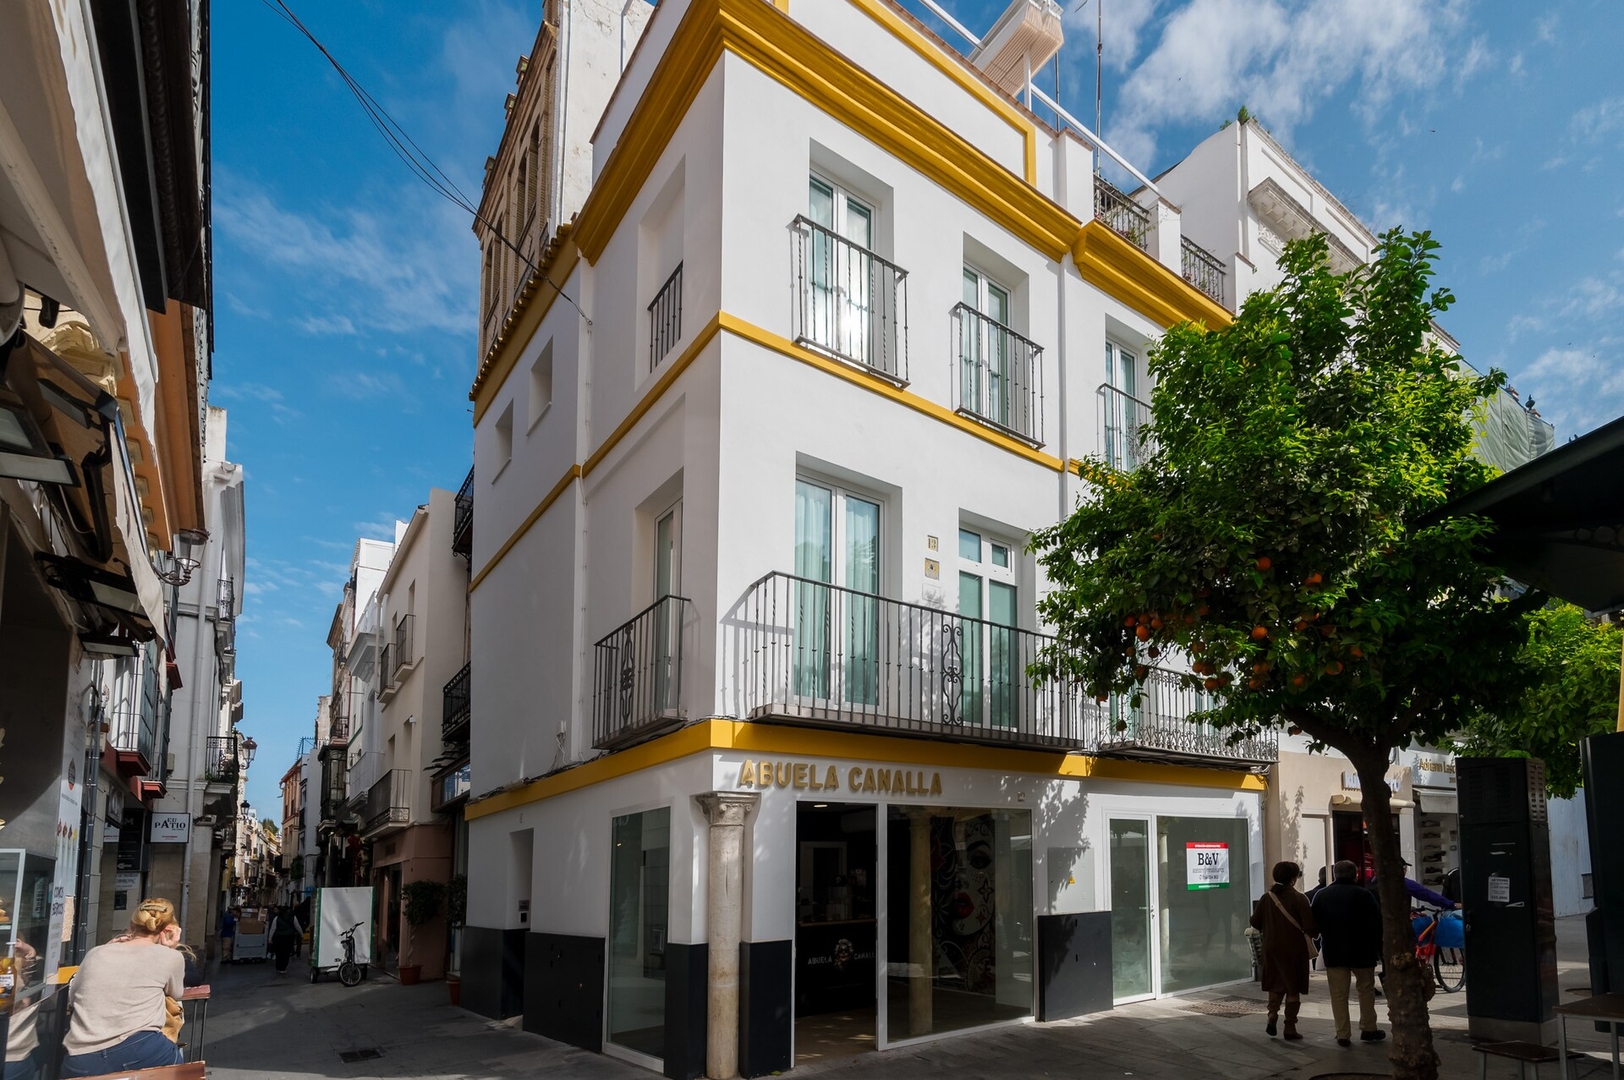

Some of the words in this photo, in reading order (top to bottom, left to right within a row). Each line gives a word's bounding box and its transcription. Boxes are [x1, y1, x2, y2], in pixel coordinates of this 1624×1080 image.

[738, 759, 840, 790] ABUELA
[848, 766, 943, 796] CANALLA
[154, 819, 186, 829] PATIO
[1197, 852, 1219, 866] B&V
[807, 956, 833, 965] ABUELA
[853, 951, 877, 960] CANALL
